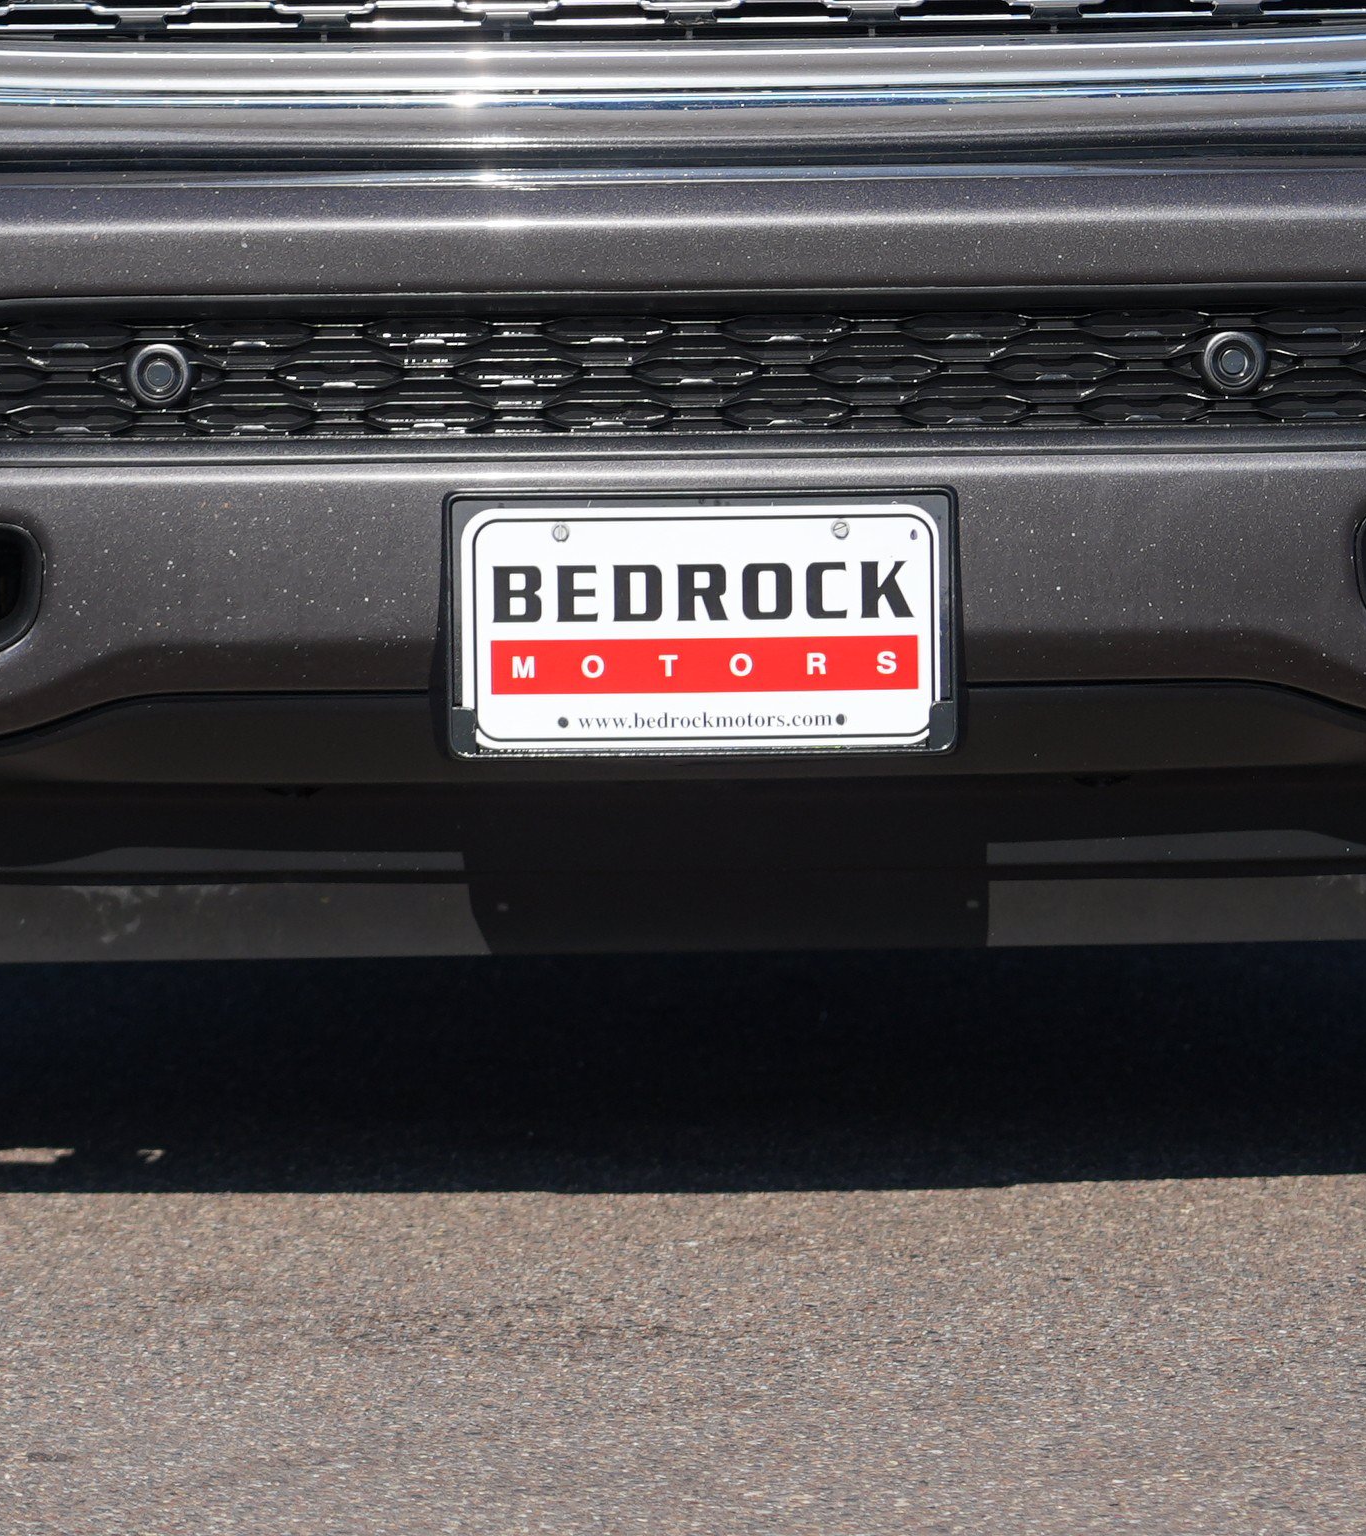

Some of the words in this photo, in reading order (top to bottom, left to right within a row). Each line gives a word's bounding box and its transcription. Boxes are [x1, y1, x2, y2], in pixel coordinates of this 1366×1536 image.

[492, 560, 915, 624] BEDROCK
[511, 650, 898, 679] MOTORS
[578, 710, 833, 730] www.bedrockmotors.com
